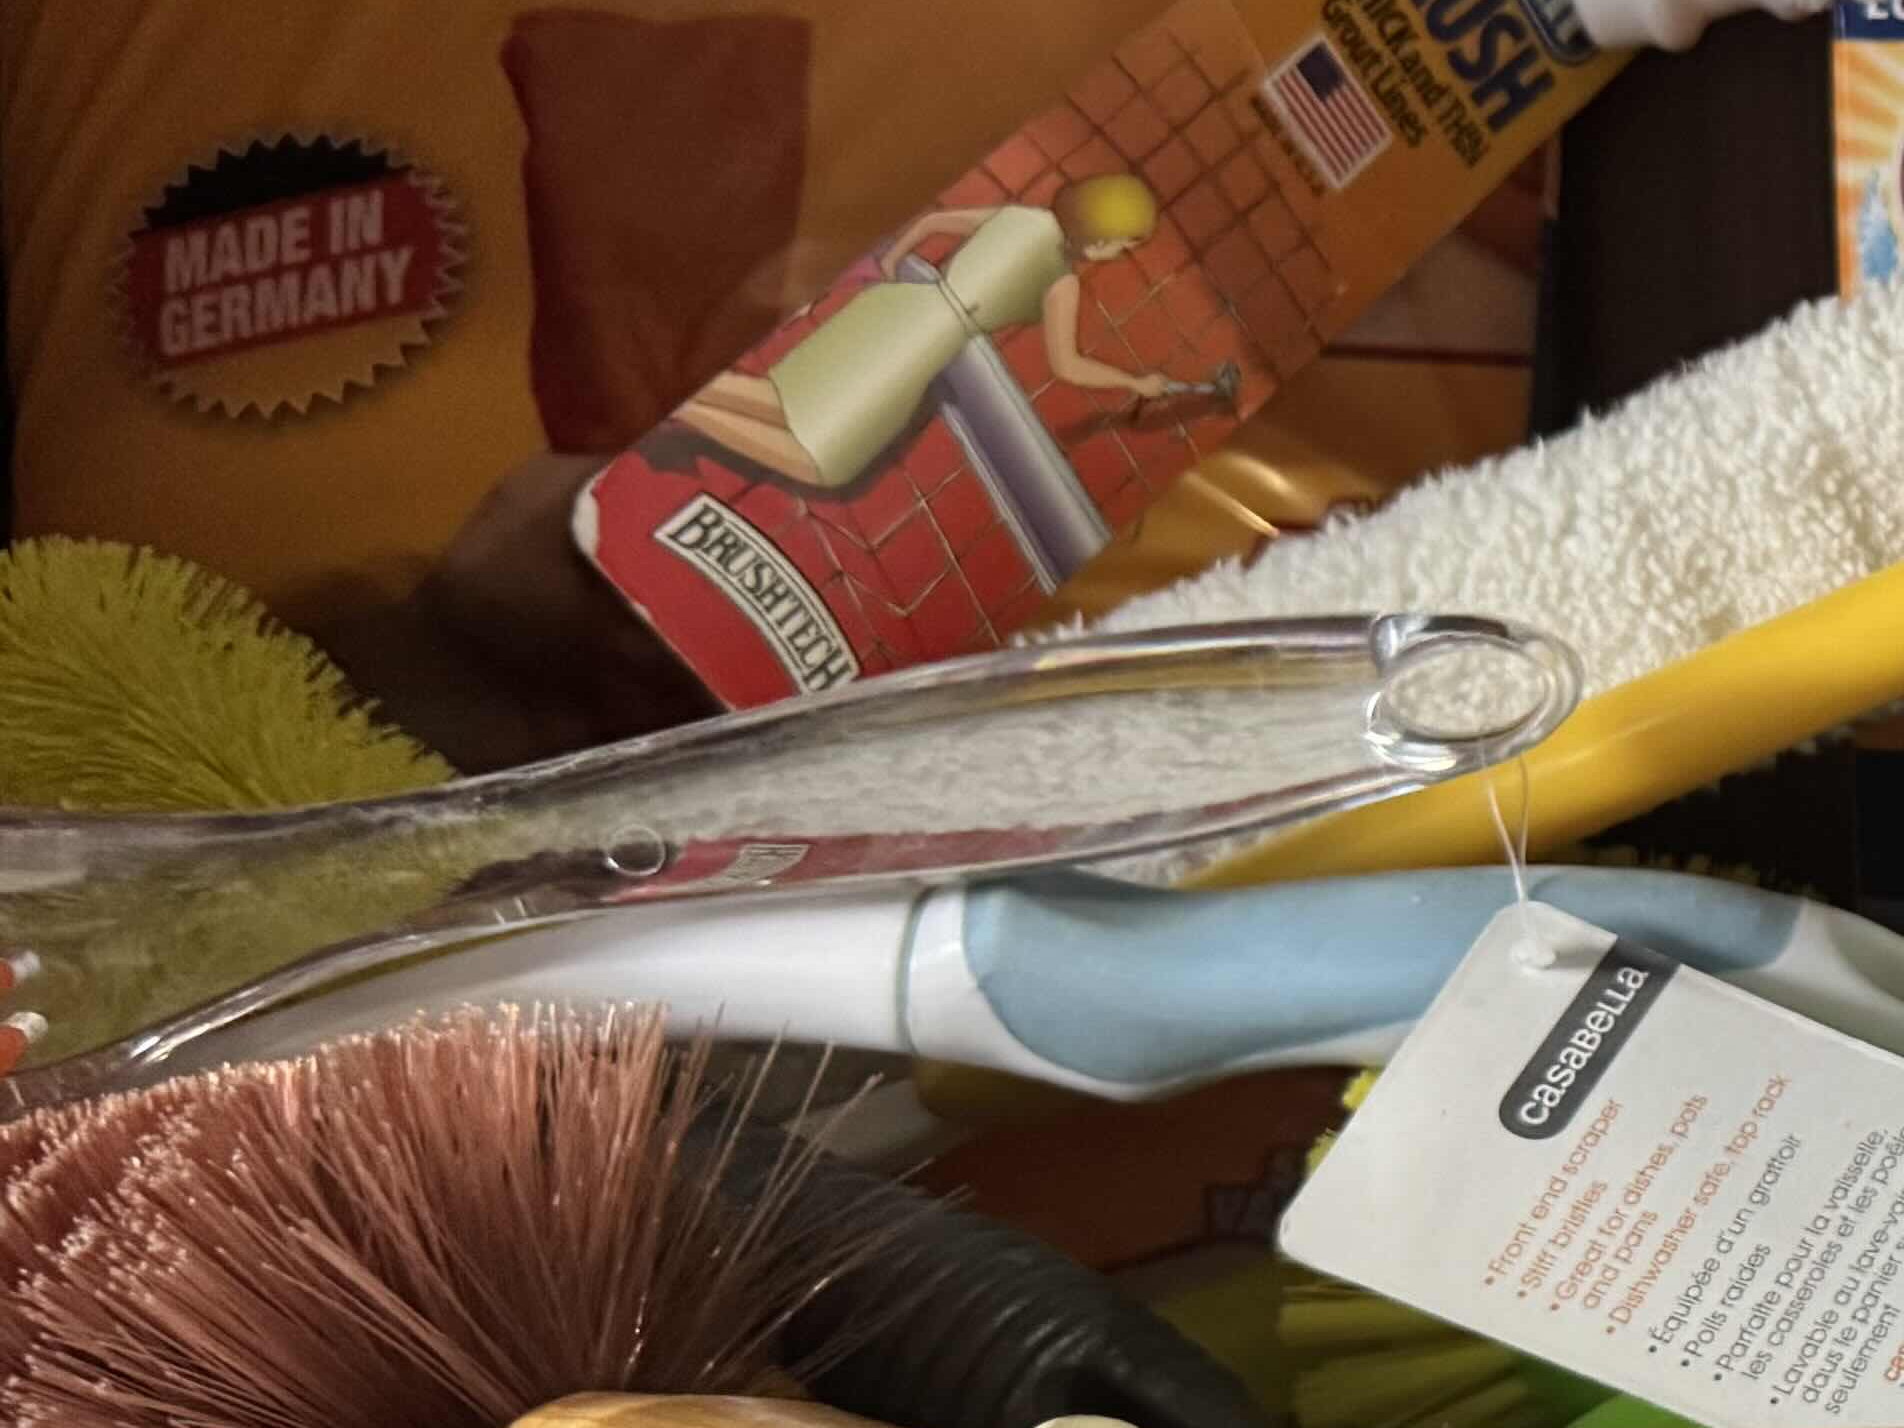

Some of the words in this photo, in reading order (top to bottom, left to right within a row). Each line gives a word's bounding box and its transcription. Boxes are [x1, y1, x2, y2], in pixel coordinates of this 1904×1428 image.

[165, 215, 310, 291] MADE
[329, 191, 384, 246] IN
[160, 247, 415, 354] GERMANY
[1488, 1222, 1536, 1275] Front
[1531, 1176, 1568, 1220] end
[1562, 1098, 1622, 1175] scraper
[1548, 1181, 1608, 1249] bristles
[1555, 1239, 1607, 1300] Great
[1597, 1208, 1628, 1236] for
[1670, 1095, 1707, 1138] pots
[1608, 1207, 1697, 1324] Dishwasher
[1724, 1121, 1757, 1154] top
[1752, 1076, 1790, 1118] rack
[1749, 1135, 1800, 1206] grattoir
[1583, 1264, 1620, 1309] and
[1613, 1212, 1658, 1264] pans
[1715, 1291, 1781, 1371] Parfaite
[1774, 1238, 1816, 1289] pour
[1804, 1215, 1831, 1235] la
[1720, 1244, 1771, 1307] raides
[1741, 1351, 1773, 1380] les
[1768, 1241, 1842, 1346] casseroles
[1837, 1216, 1856, 1237] et
[1848, 1186, 1878, 1214] les
[1832, 1326, 1857, 1347] le
[1851, 1255, 1902, 1331] panier
[1772, 1310, 1839, 1396] Lavable
[1834, 1276, 1860, 1306] au
[1825, 1304, 1900, 1414] seulement
